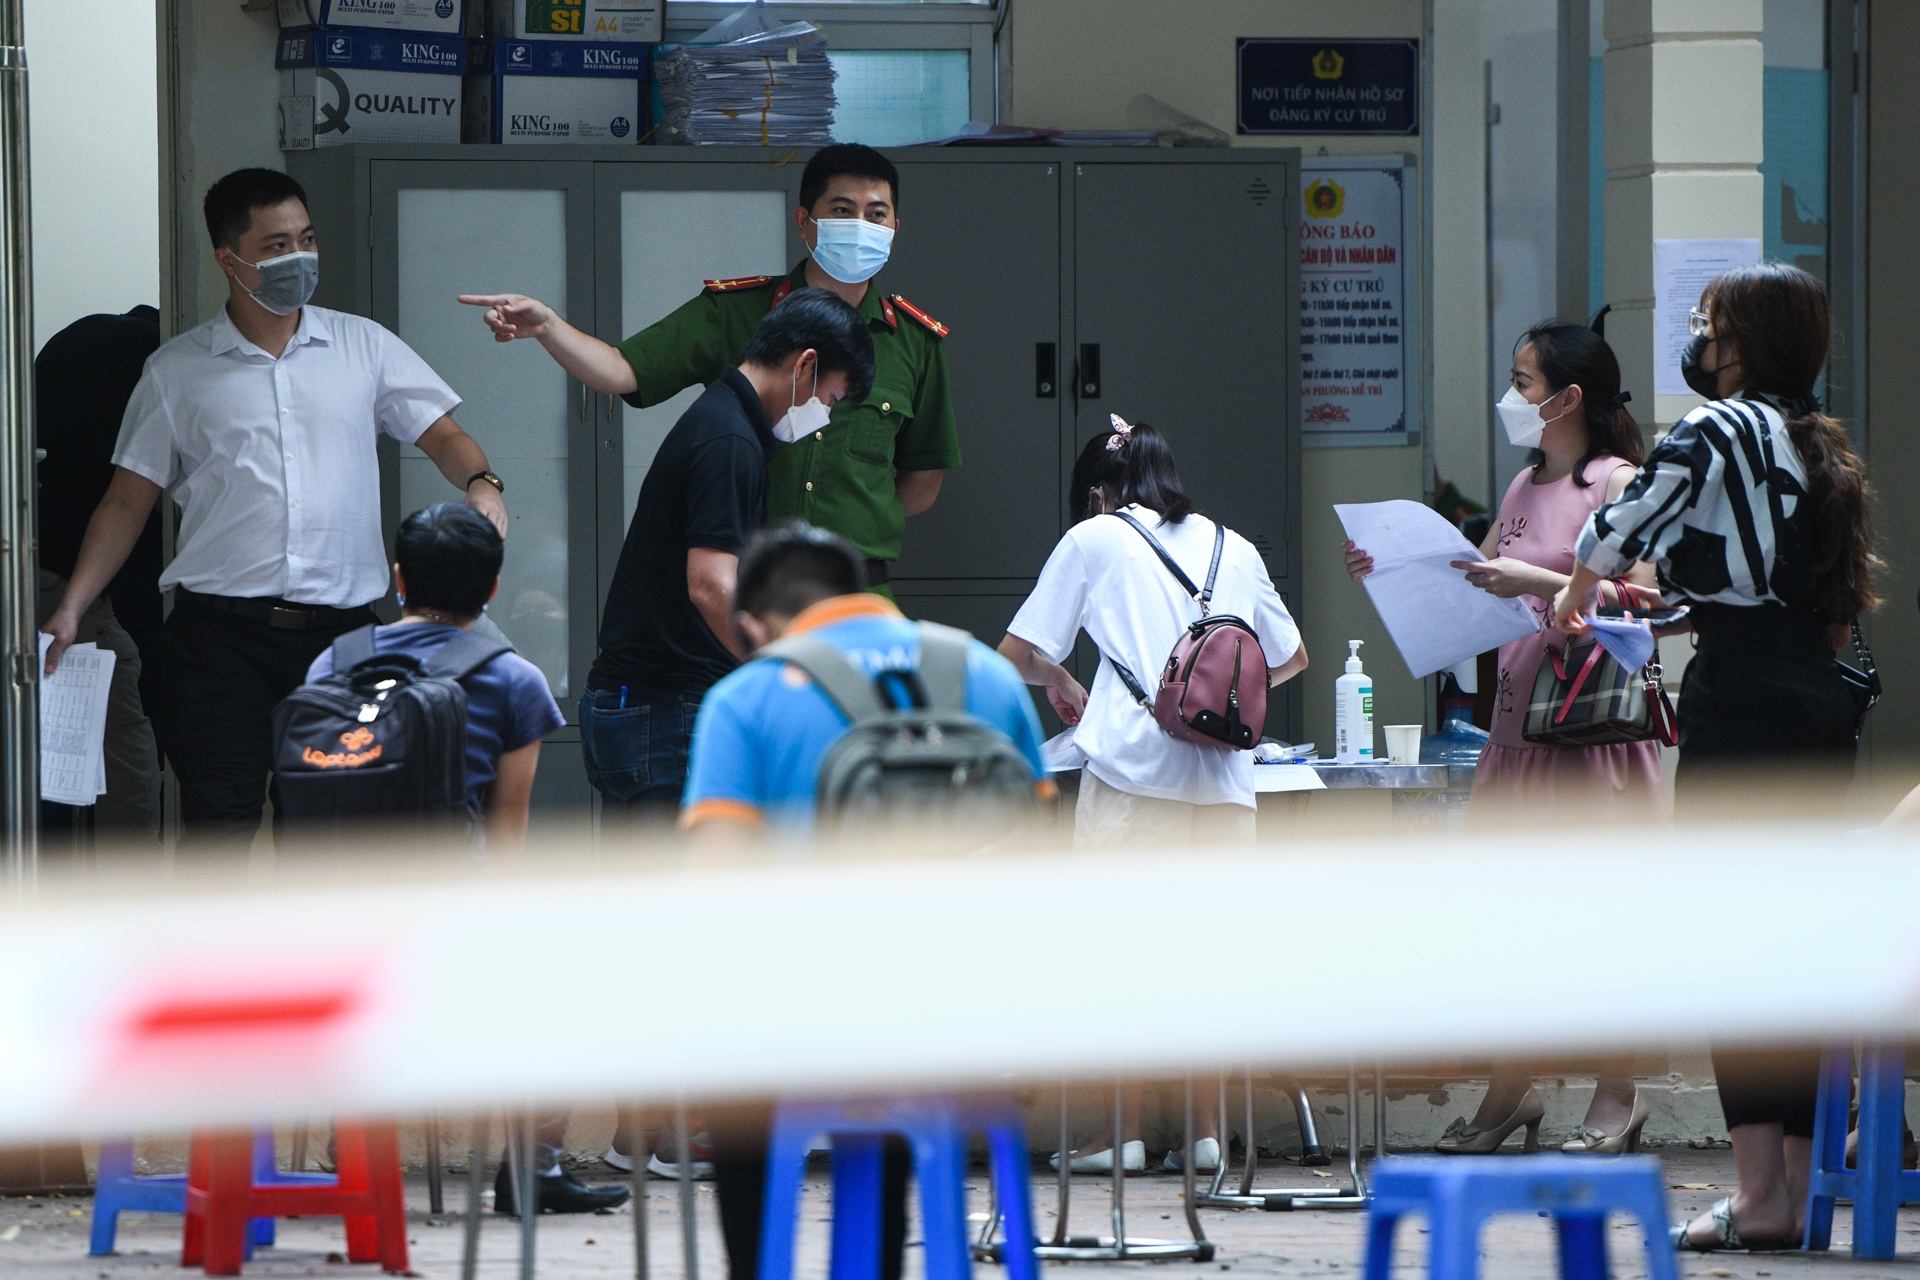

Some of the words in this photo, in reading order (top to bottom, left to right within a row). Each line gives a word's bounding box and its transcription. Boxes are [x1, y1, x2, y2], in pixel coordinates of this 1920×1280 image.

[380, 1, 396, 9] 100
[438, 0, 451, 8] A4
[595, 16, 618, 32] A4
[402, 43, 440, 60] KING
[441, 53, 457, 61] 100
[583, 49, 622, 64] KING
[1252, 86, 1278, 100] NƠI
[1282, 82, 1311, 100] TIẾP
[1315, 85, 1356, 103] NHẬN
[1360, 83, 1381, 101] HỒ
[1385, 88, 1404, 101] SƠ
[354, 93, 456, 116] QUALITY
[1270, 105, 1310, 122] ĐĂNG
[1314, 105, 1331, 122] KÝ
[1335, 108, 1356, 122] CƯ
[1360, 106, 1386, 122] TRÚ
[511, 115, 550, 130] KING
[553, 123, 570, 131] 100
[614, 118, 627, 127] A4
[292, 138, 310, 148] QUALITY
[1301, 222, 1335, 239] ÔNG
[1340, 222, 1376, 239] BÁO
[1320, 245, 1332, 267] BỘ
[1336, 245, 1346, 264] VÀ
[1349, 244, 1374, 264] NHÂN
[1377, 244, 1396, 264] DÂN
[1311, 277, 1329, 293] KÝ
[1334, 278, 1353, 292] CƯ
[1356, 276, 1384, 292] TRÚ
